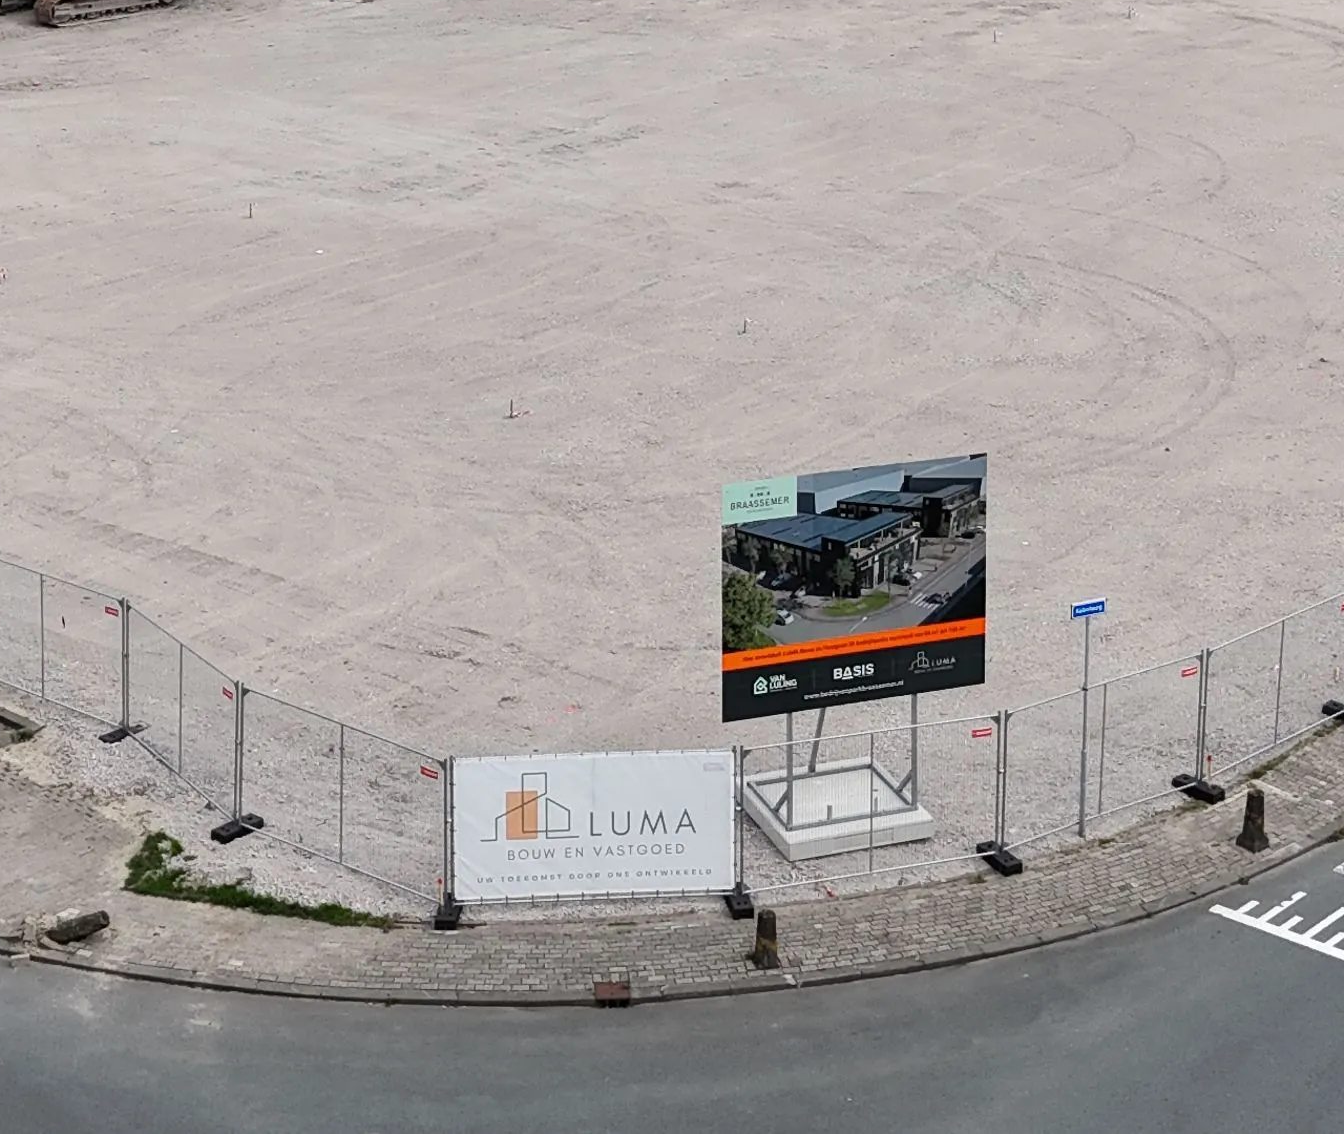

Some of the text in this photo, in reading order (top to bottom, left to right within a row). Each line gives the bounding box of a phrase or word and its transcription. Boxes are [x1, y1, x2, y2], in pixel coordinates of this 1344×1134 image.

[833, 663, 874, 680] BASIS
[589, 808, 697, 836] LUMA
[507, 843, 685, 861] BOUW EN VASTGOED
